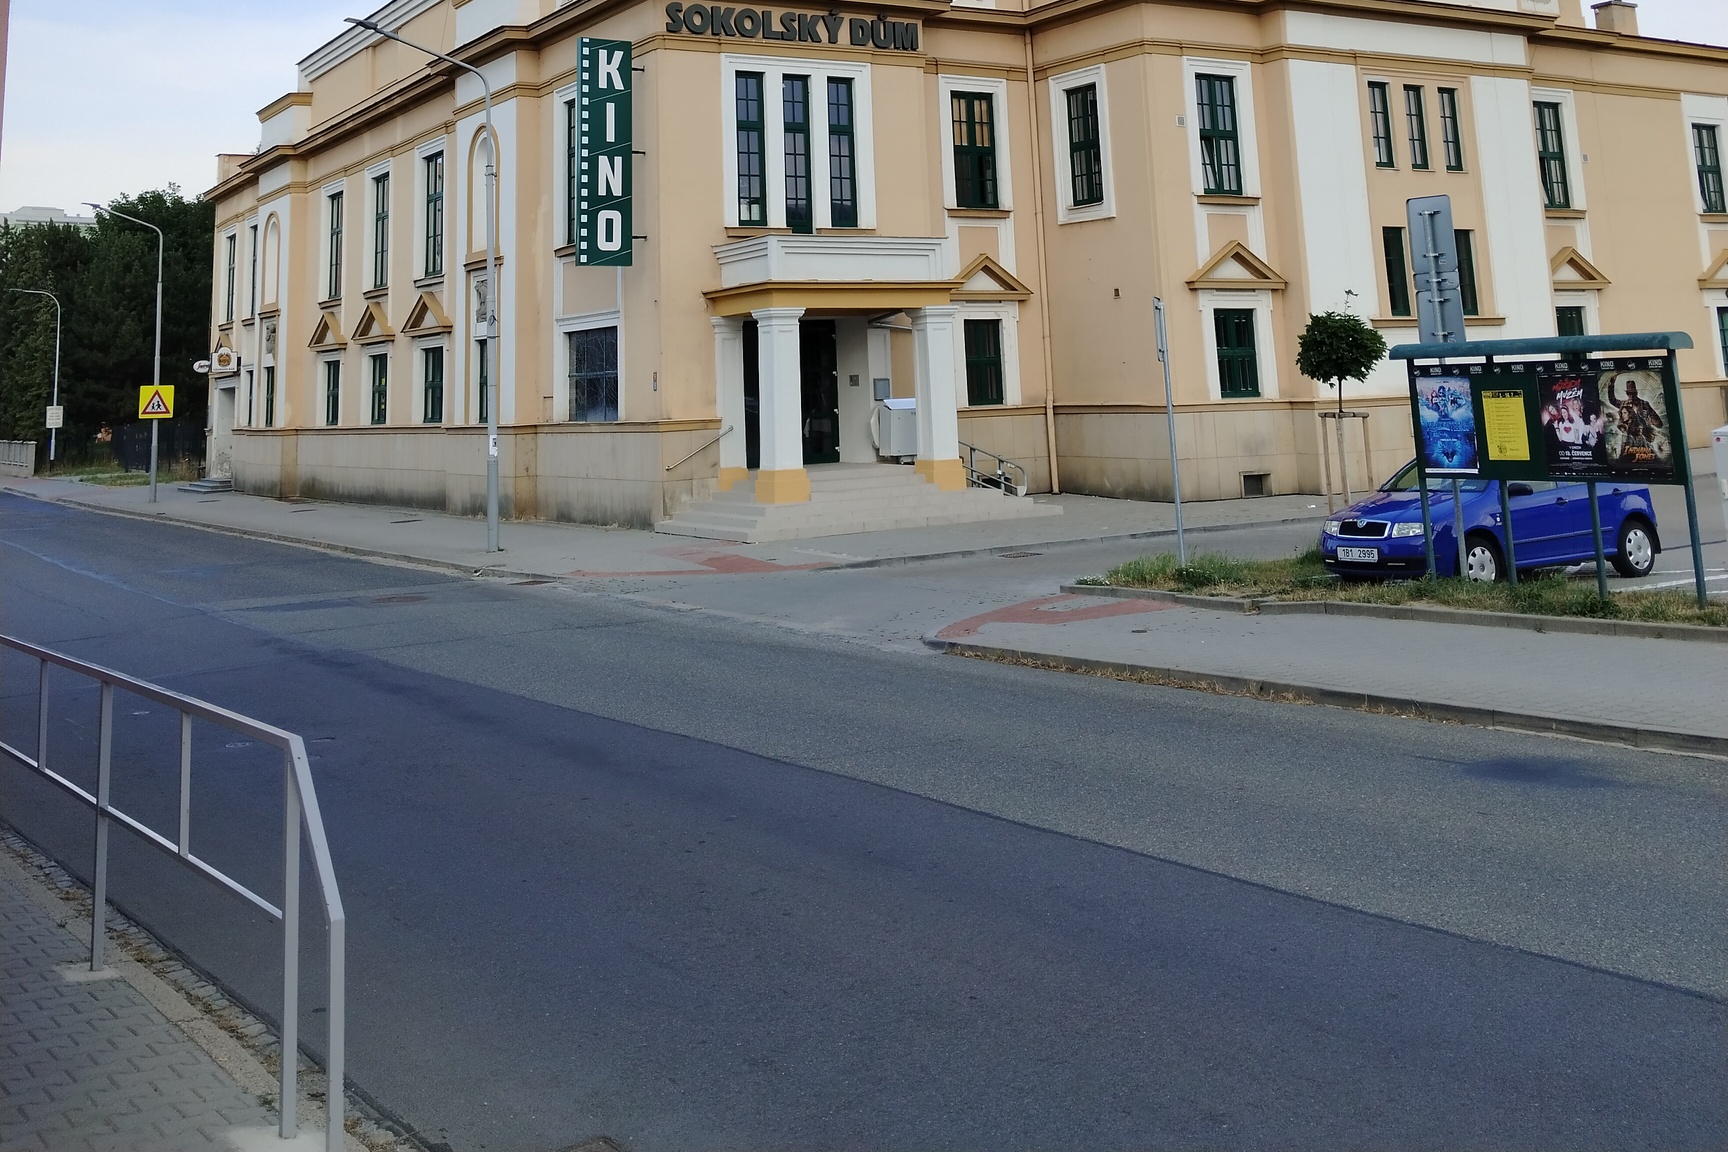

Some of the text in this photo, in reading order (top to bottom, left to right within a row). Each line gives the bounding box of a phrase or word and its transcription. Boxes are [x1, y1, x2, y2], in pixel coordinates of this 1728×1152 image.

[665, 2, 919, 51] SOKOLSKÝ DŮM
[596, 49, 625, 251] KINO
[1342, 548, 1375, 558] 1B1 2995
